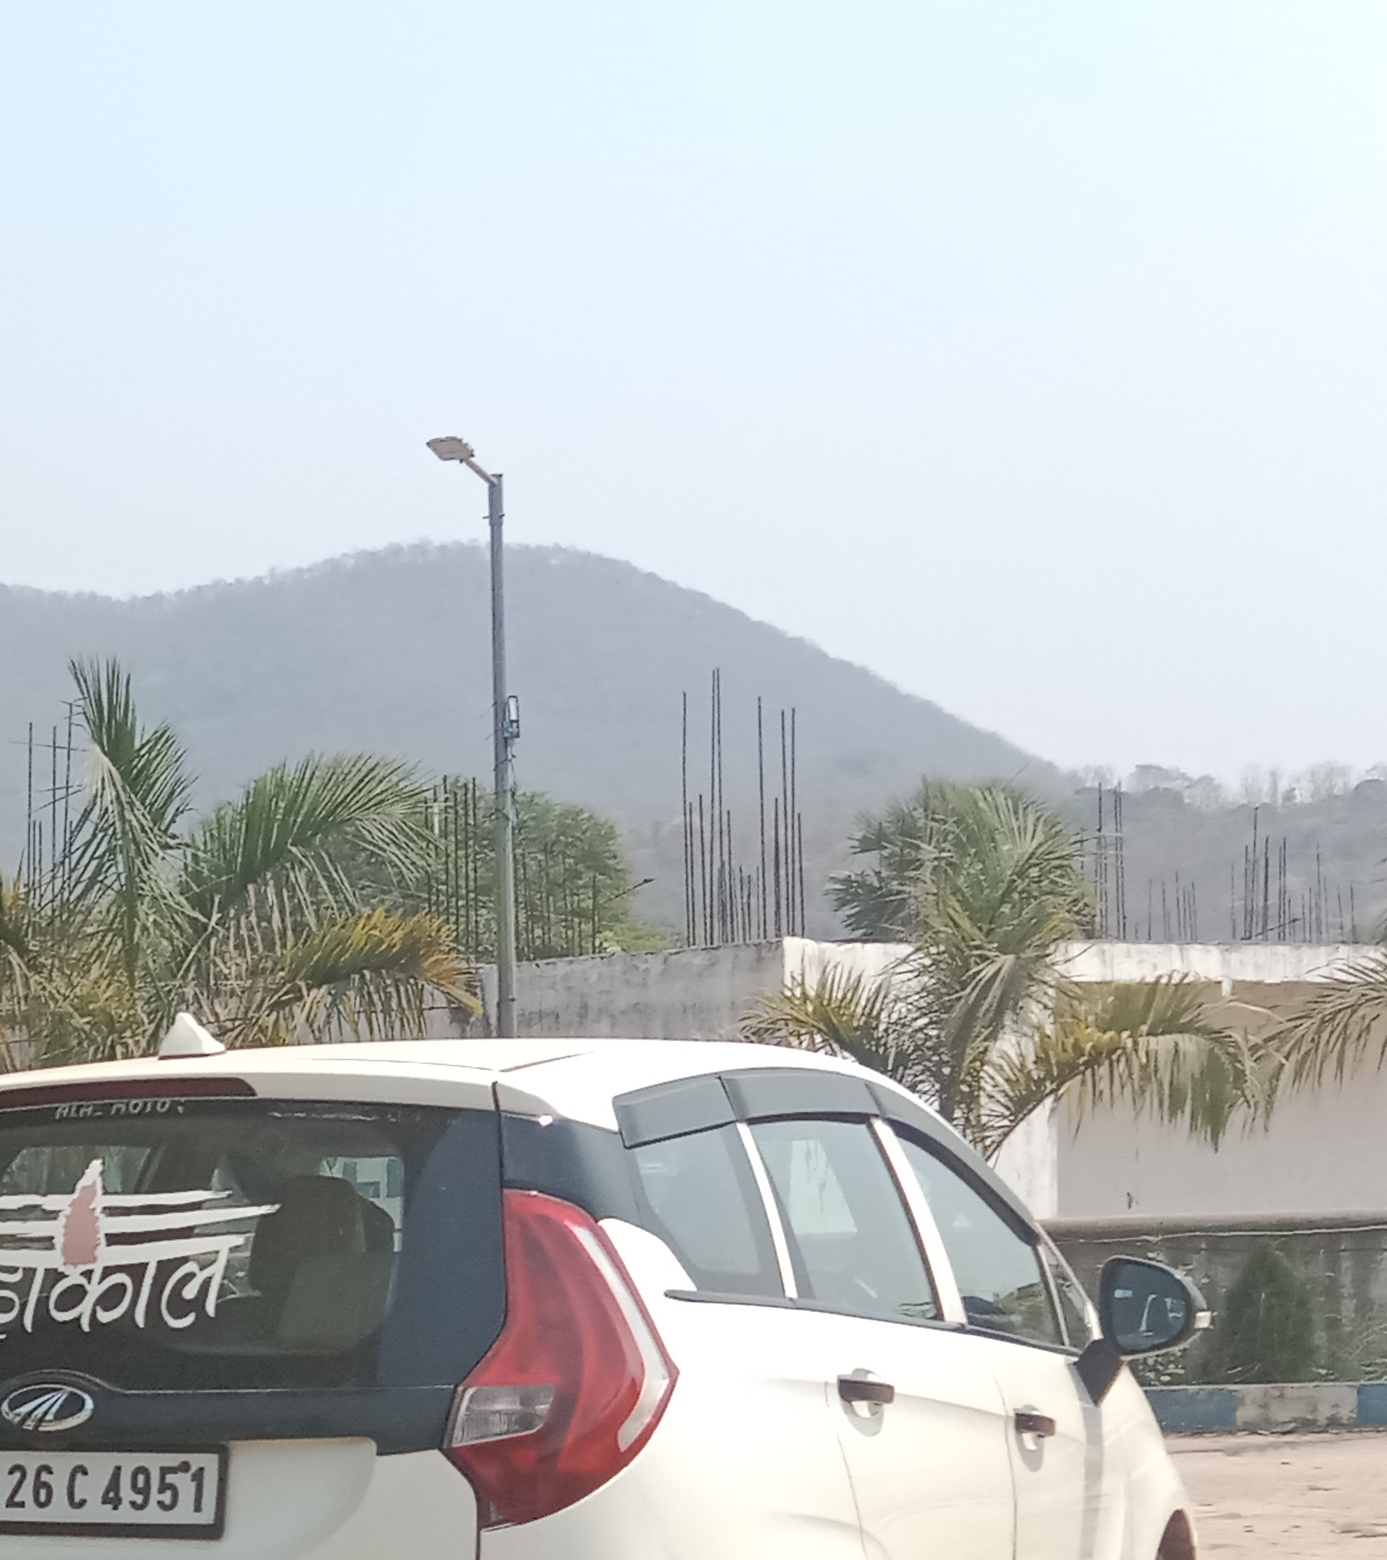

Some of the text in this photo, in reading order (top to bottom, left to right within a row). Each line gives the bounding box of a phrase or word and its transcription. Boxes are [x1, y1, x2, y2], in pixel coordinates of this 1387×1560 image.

[6, 1464, 54, 1509] 26
[66, 1464, 89, 1509] C
[101, 1465, 206, 1513] 4951
